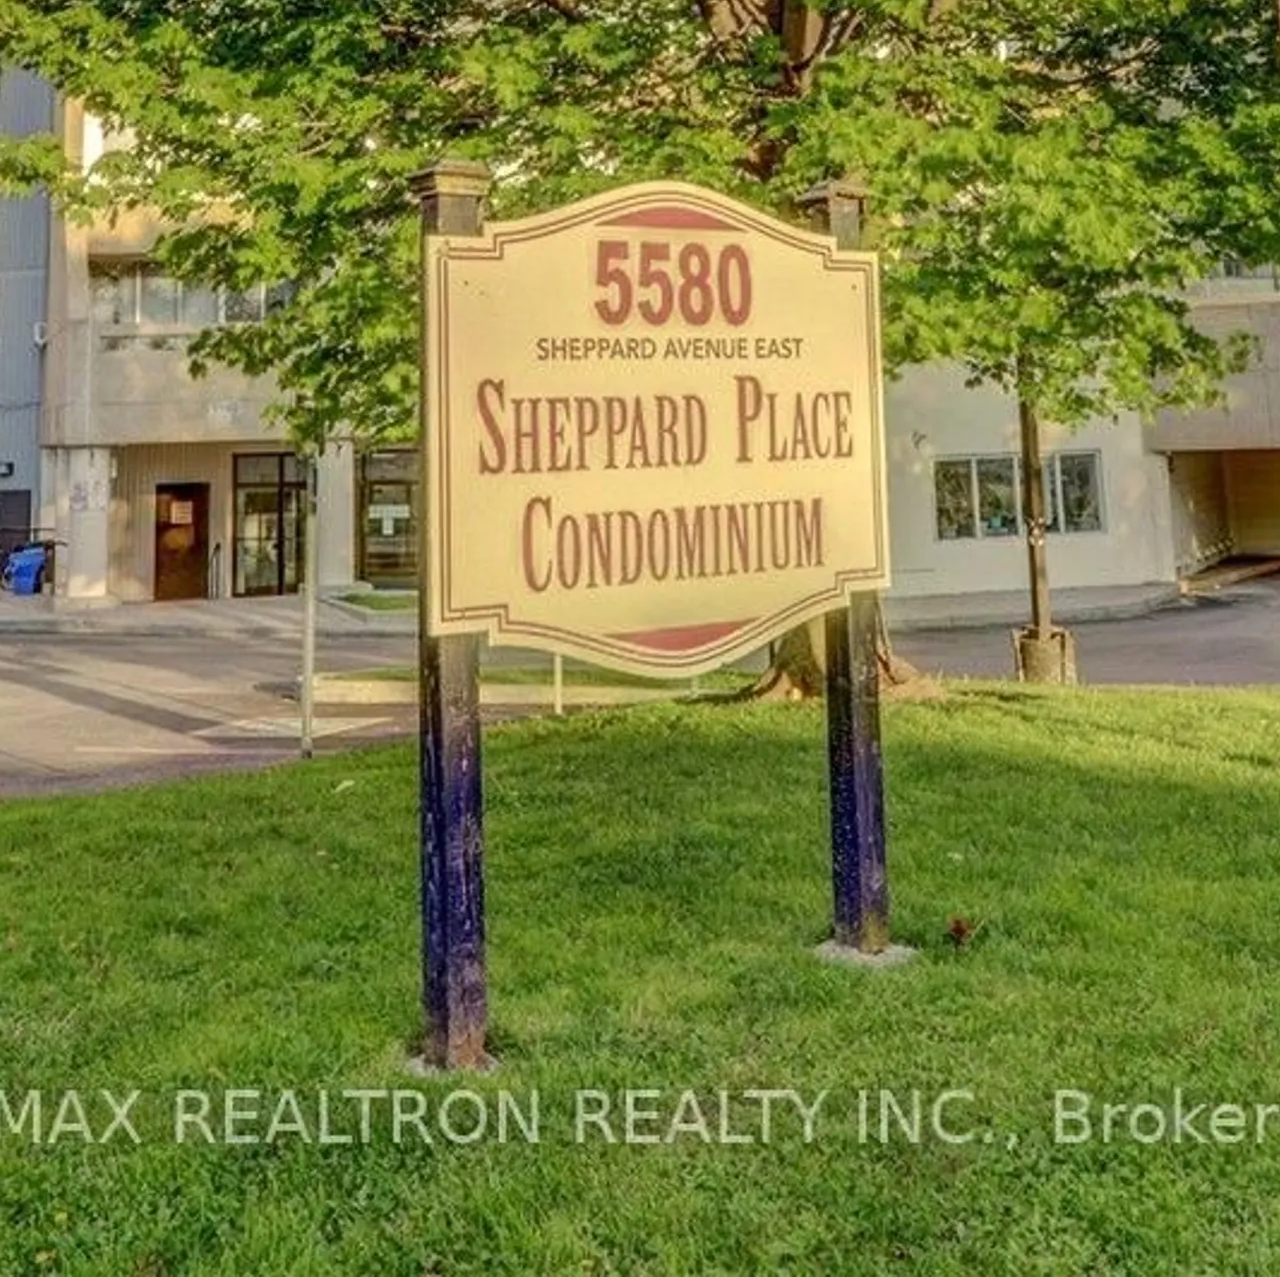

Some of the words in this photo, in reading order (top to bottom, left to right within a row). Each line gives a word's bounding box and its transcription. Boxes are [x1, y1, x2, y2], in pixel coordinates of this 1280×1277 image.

[594, 239, 752, 327] 5580
[535, 336, 657, 362] SHEPPARD
[663, 336, 748, 361] AVENUE
[754, 336, 804, 360] EAST
